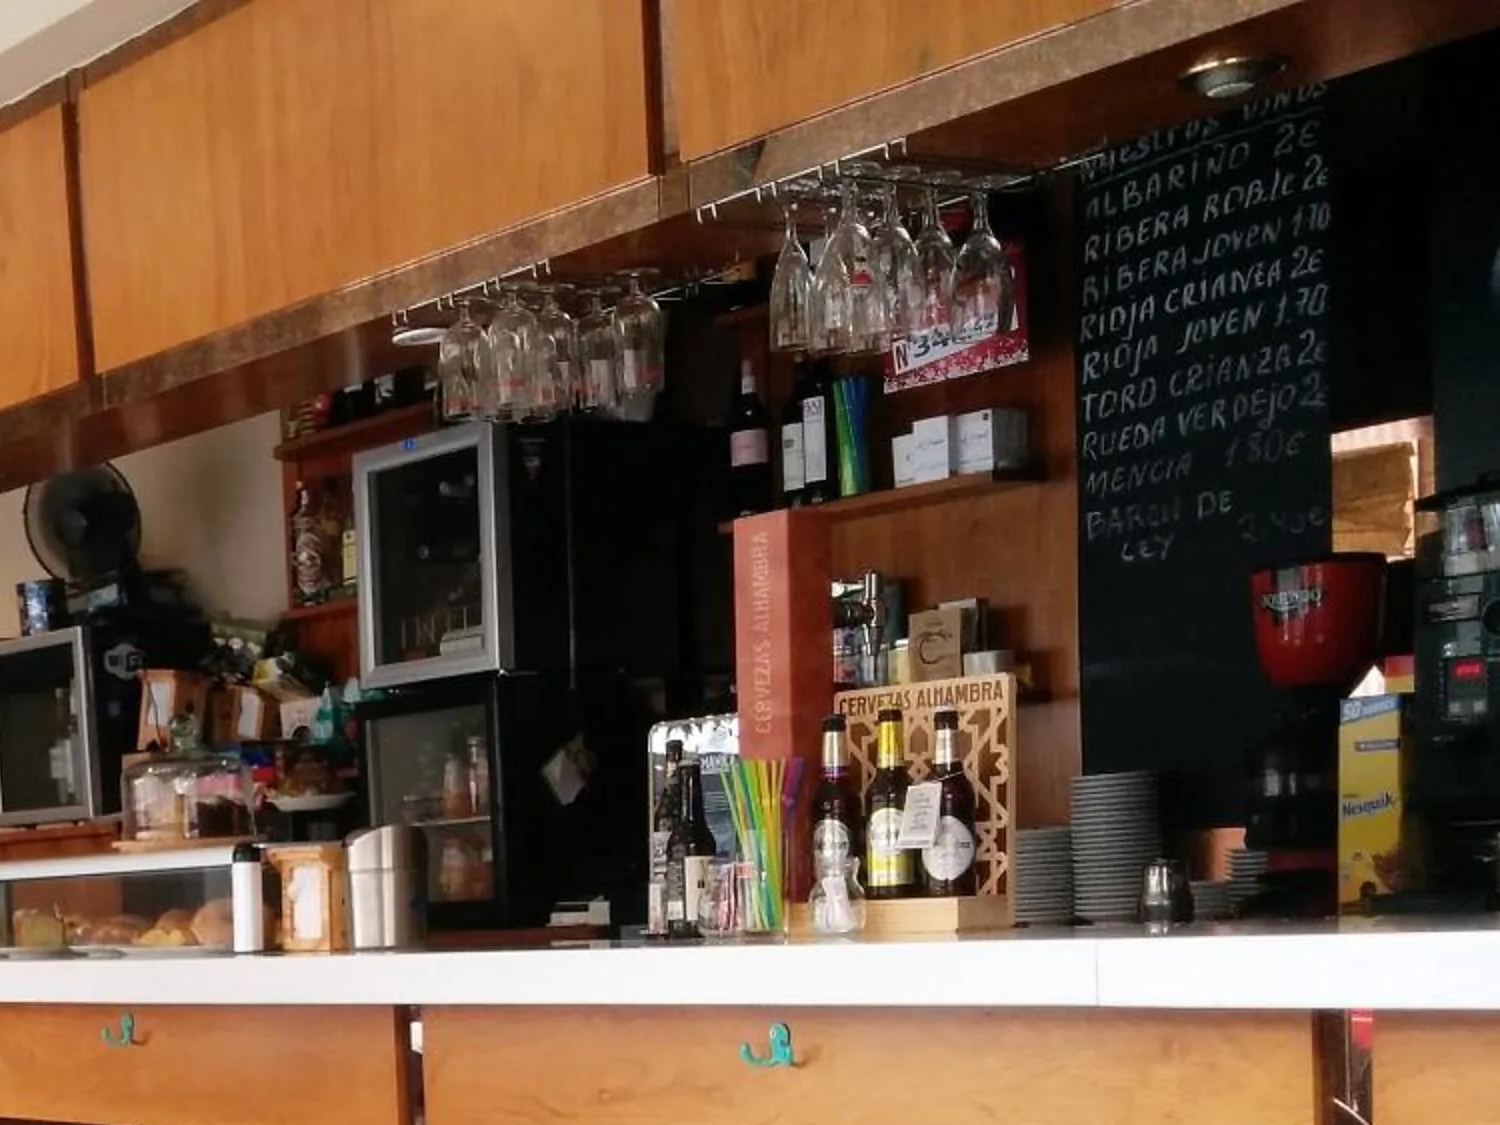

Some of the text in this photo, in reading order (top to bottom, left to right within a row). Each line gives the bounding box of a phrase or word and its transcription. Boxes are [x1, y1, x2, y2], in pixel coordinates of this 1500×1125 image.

[1085, 205, 1189, 264] RIBERA
[1083, 246, 1187, 307] RIBERA
[1082, 336, 1157, 385] RIOJA
[1082, 377, 1157, 423] TORO
[1082, 416, 1166, 461] RUEDA
[1198, 491, 1233, 520] DE
[751, 532, 772, 734] CERVEZAS ALHAMBRA
[839, 679, 1003, 717] CERVEZAS ALHAMBRA
